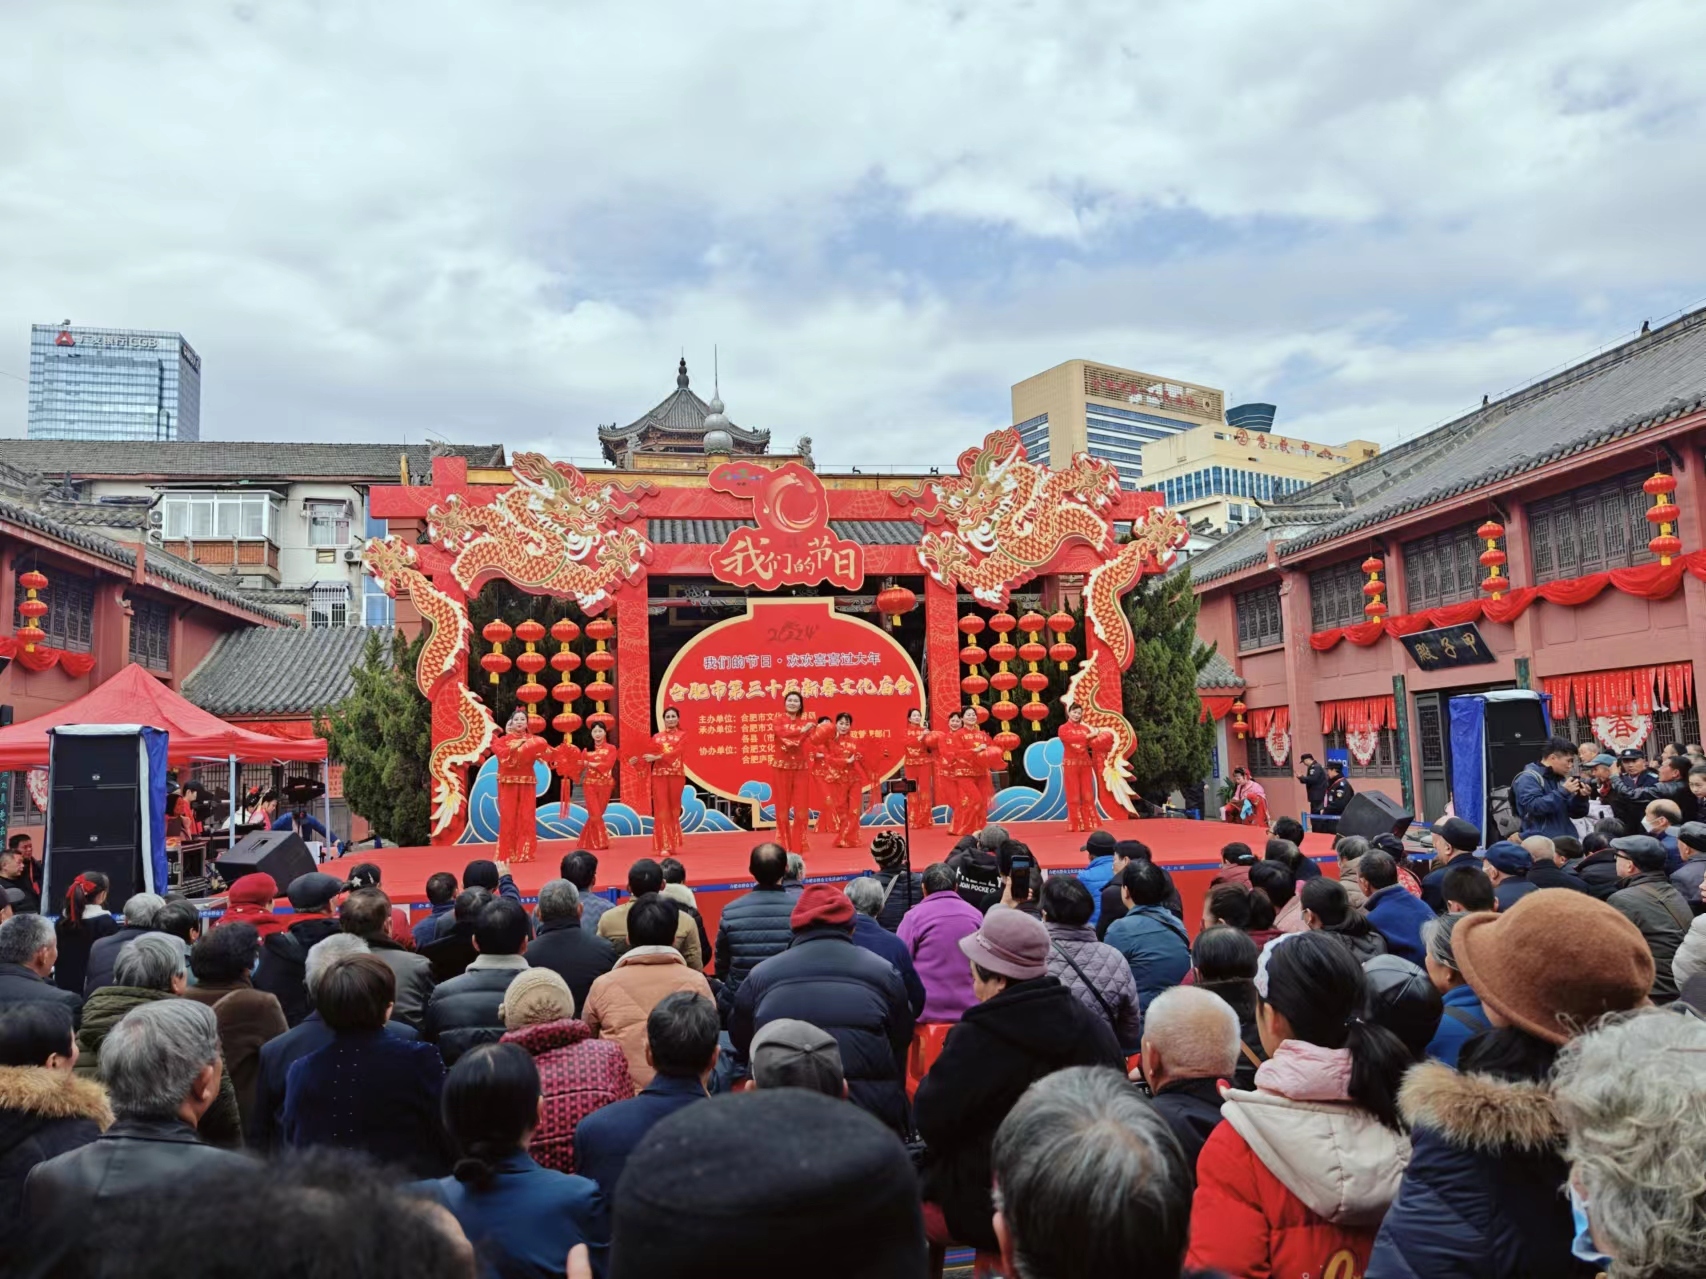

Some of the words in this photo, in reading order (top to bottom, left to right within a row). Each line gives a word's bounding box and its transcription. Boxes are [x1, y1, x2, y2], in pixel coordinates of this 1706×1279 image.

[720, 536, 855, 580] 我们的节日
[1608, 715, 1638, 738] 春
